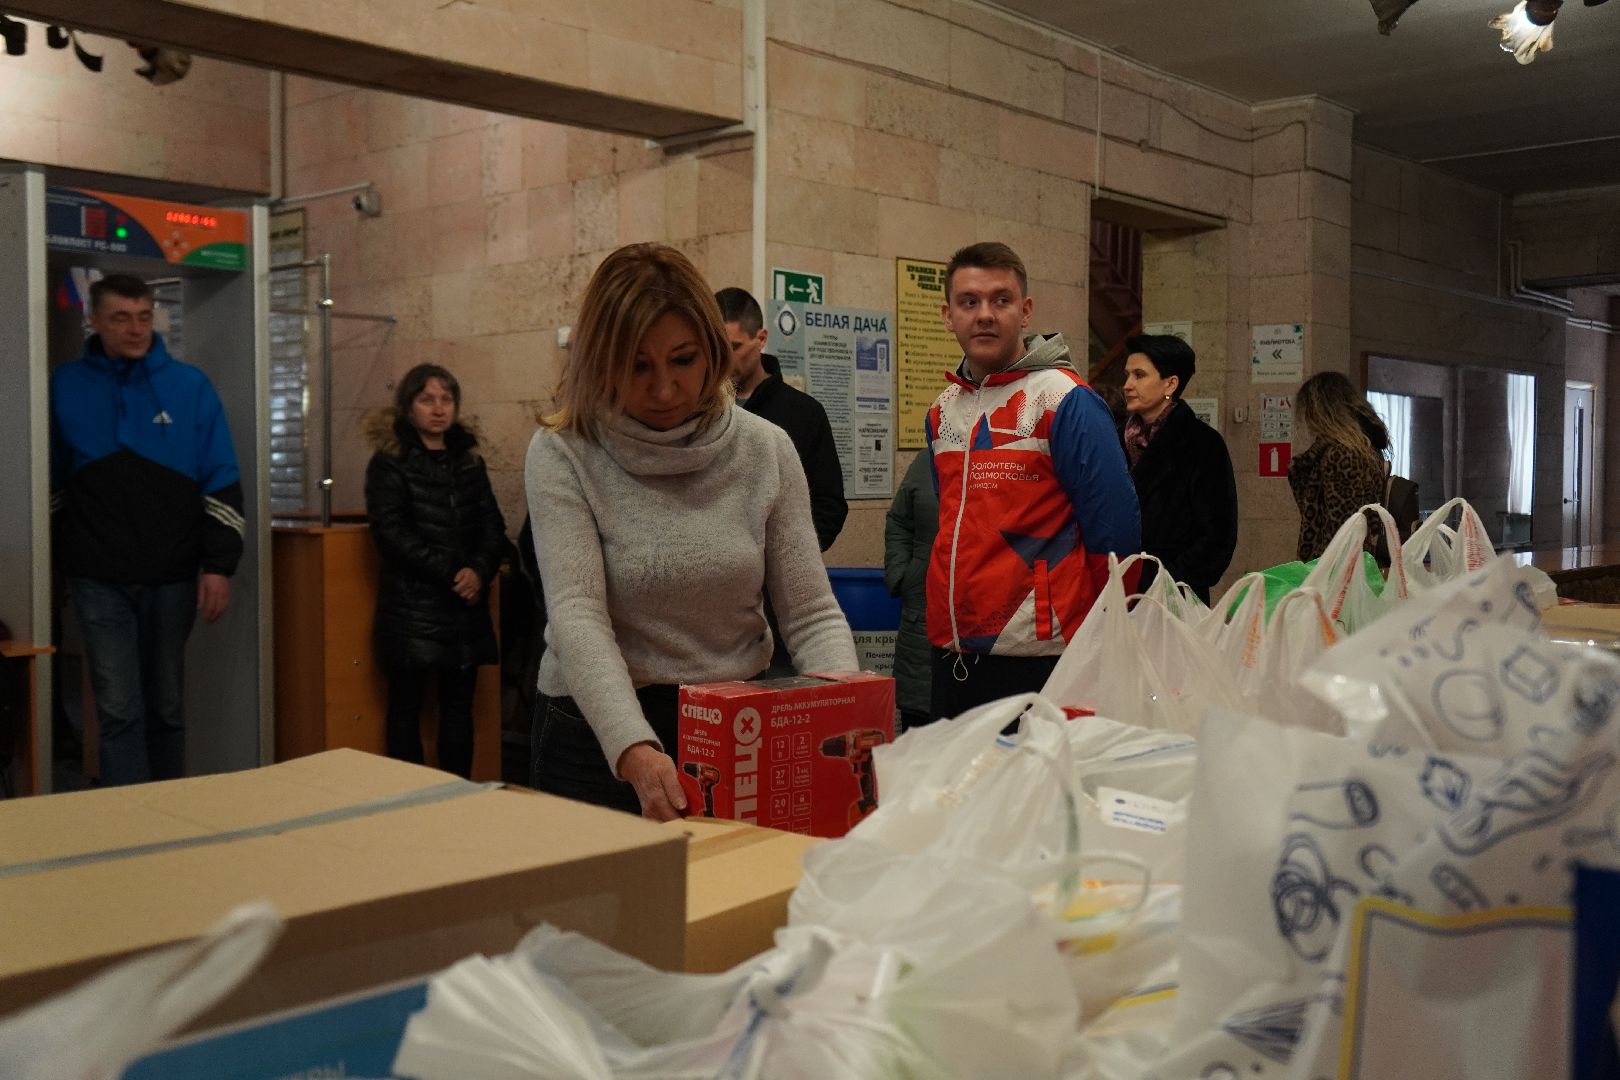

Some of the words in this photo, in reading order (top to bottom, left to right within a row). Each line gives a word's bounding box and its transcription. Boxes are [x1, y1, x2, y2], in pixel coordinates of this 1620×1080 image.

[805, 311, 849, 329] БЕЛАЯ
[853, 316, 888, 334] ДАЧА
[969, 471, 1040, 482] ПОДМОСКОВЬЯ
[875, 635, 897, 646] кры
[770, 703, 793, 714] ДРЕЛЬ
[793, 696, 856, 711] АККУМУЛЯТОРНАЯ
[770, 713, 811, 729] БДА-12-2
[687, 744, 716, 758] БДА-12-2
[775, 769, 785, 779] 27
